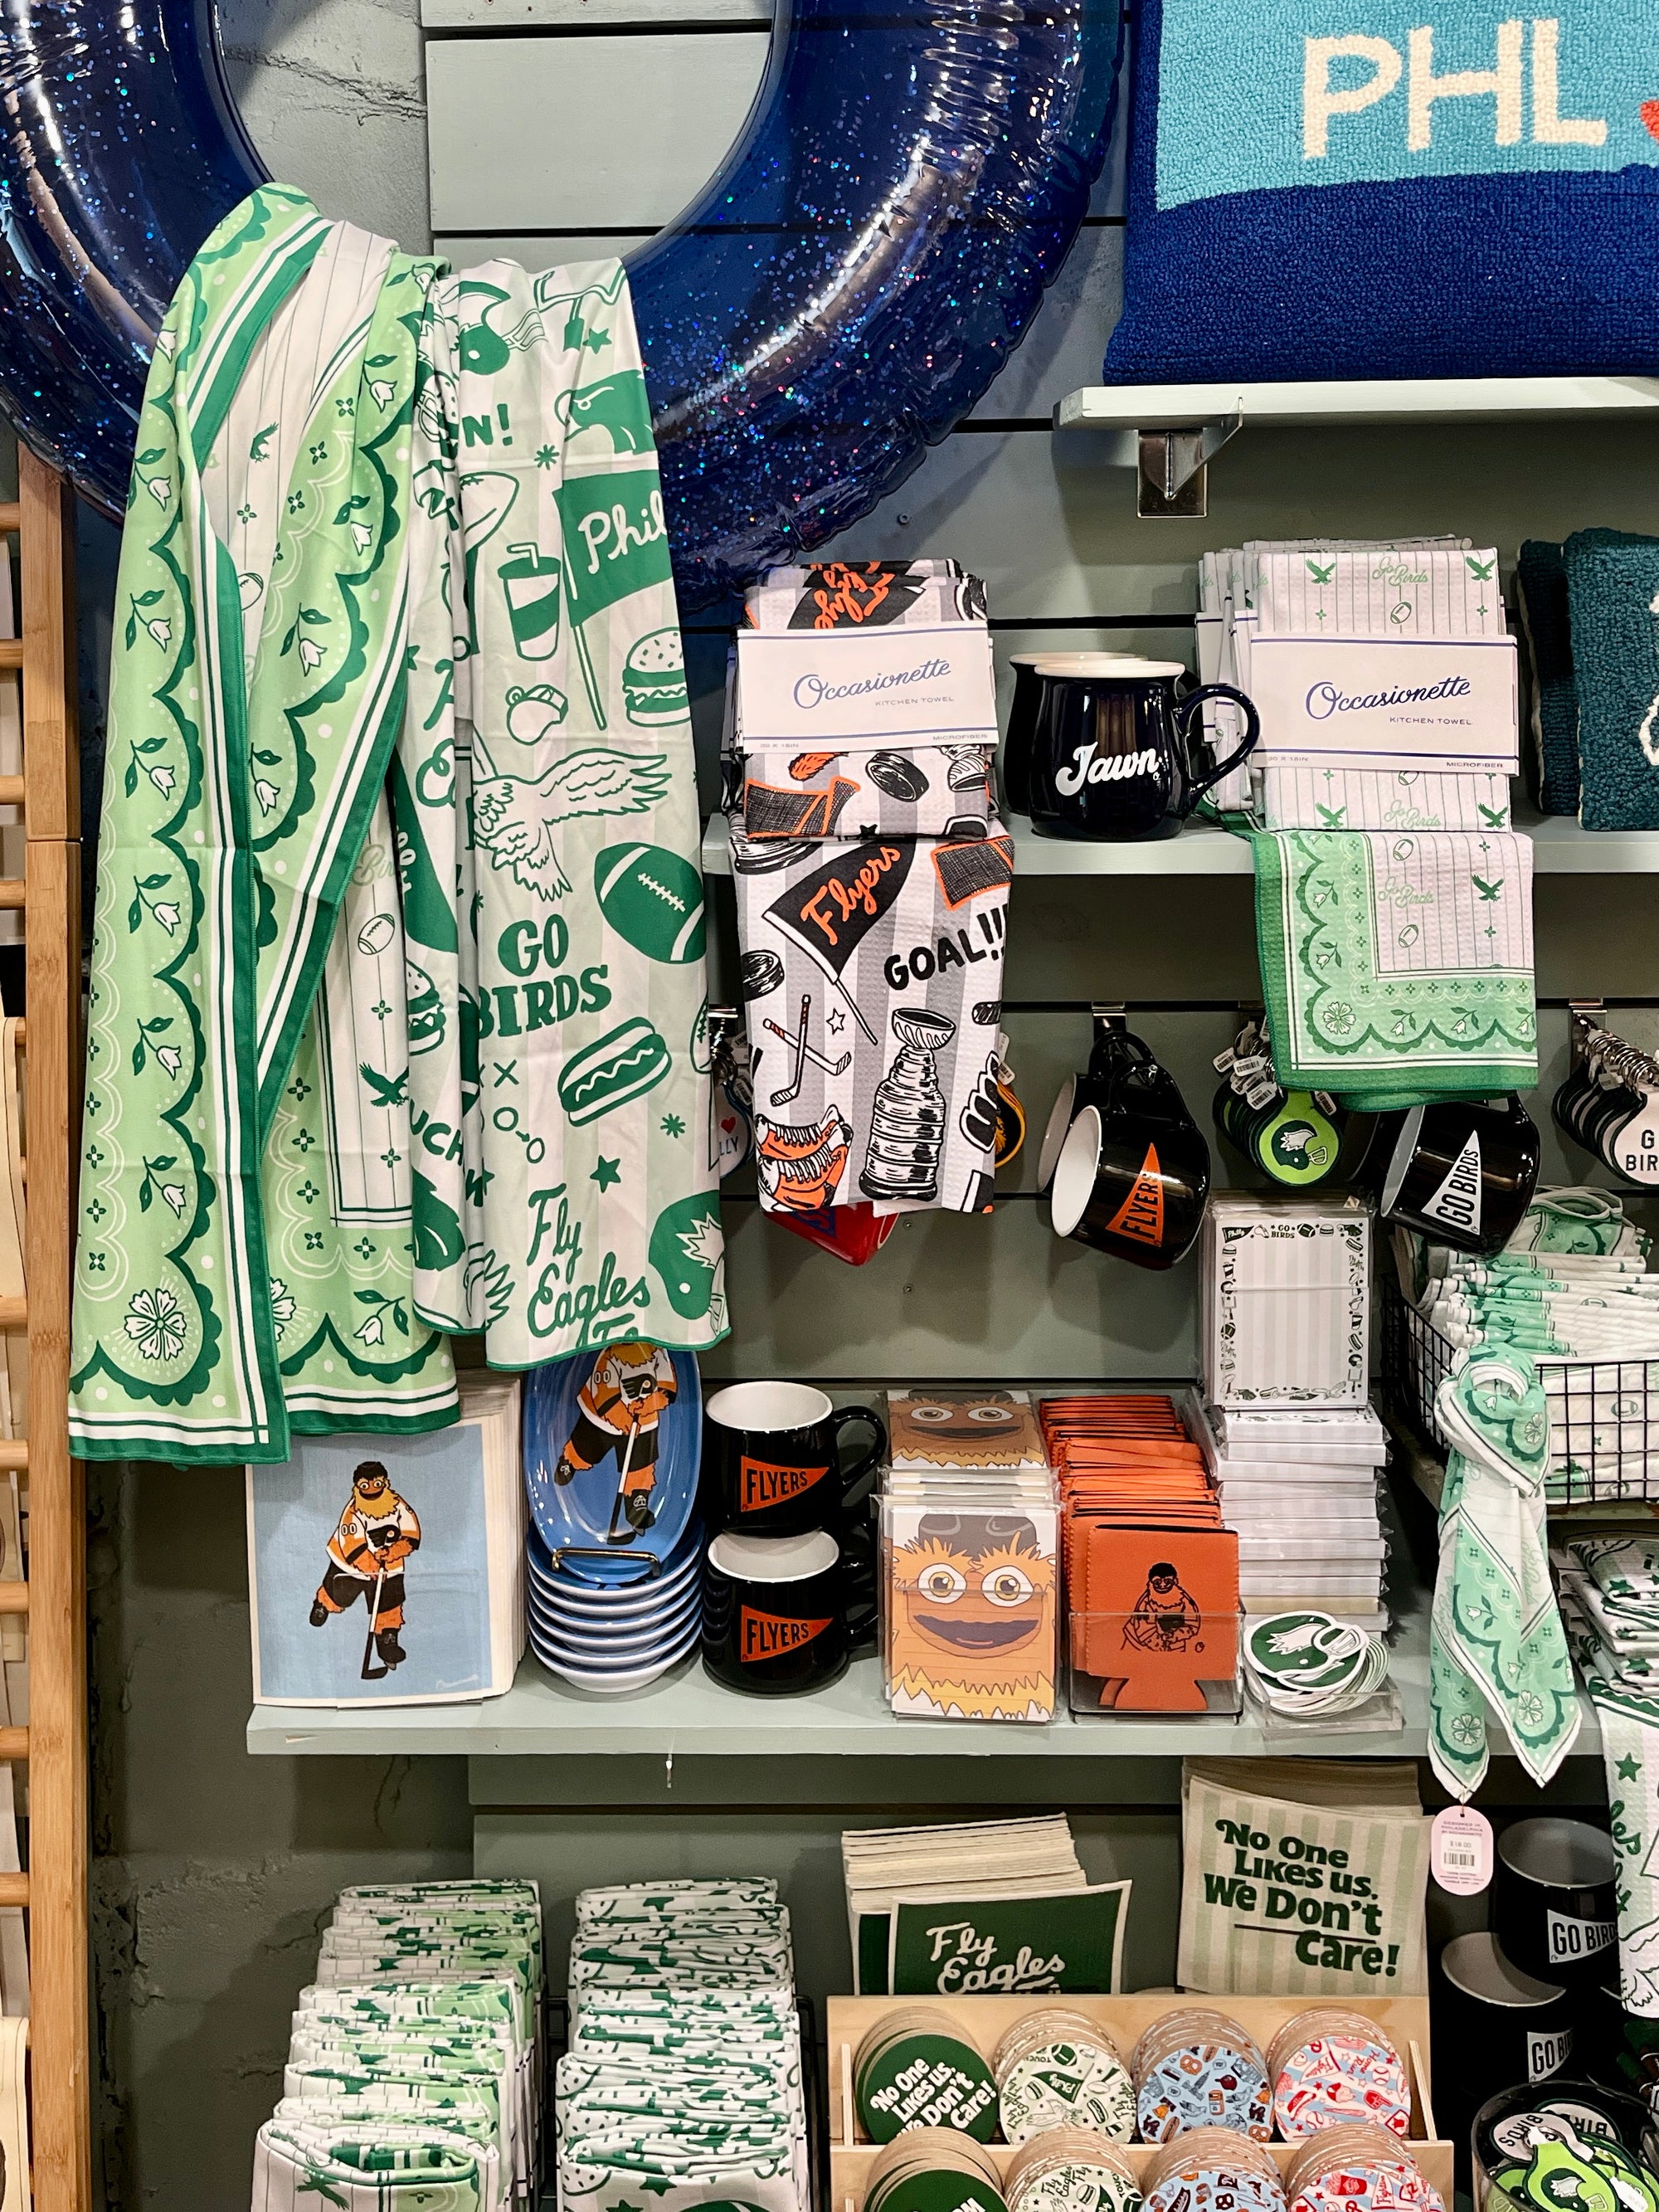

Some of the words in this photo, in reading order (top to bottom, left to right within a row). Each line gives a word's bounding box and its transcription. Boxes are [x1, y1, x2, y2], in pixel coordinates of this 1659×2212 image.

[1303, 18, 1607, 160] PHL
[577, 491, 668, 574] Phil
[1389, 563, 1428, 587] Birds
[793, 659, 951, 709] Occasionette
[875, 698, 917, 706] KITCHEN
[1306, 675, 1471, 720] Occasionette
[1437, 718, 1472, 726] TOWEL
[1055, 741, 1159, 797] Jawn
[800, 845, 901, 946] Flyers
[498, 914, 569, 977] GO
[884, 903, 1007, 991] GOAL!!
[410, 1099, 464, 1166] UCH
[1641, 1129, 1655, 1149] G
[1452, 1149, 1479, 1196] BIRDS
[1626, 1154, 1658, 1171] BIR
[1120, 1171, 1160, 1239] FLYERS
[1436, 1193, 1475, 1226] GO
[526, 1182, 582, 1284] Fly
[528, 1251, 650, 1348] Eagles
[747, 1468, 808, 1504] FLYERS
[747, 1619, 809, 1654] FLYERS
[1215, 1819, 1270, 1850] No
[1279, 1836, 1349, 1868] One
[1204, 1873, 1257, 1911] We
[1265, 1887, 1383, 1936] Don't
[1331, 1873, 1378, 1899] us.
[926, 1922, 998, 1966] Fly
[1296, 1930, 1400, 1977] Care!
[1552, 1922, 1582, 1956] GO
[1584, 1922, 1617, 1951] BIRD
[937, 1946, 1065, 1995] Eagles
[1532, 2040, 1555, 2074] GO
[870, 2086, 899, 2112] No
[895, 2058, 930, 2092] One
[919, 2071, 975, 2127] Don't
[950, 2079, 997, 2130] Care!
[1041, 2178, 1062, 2195] Fly
